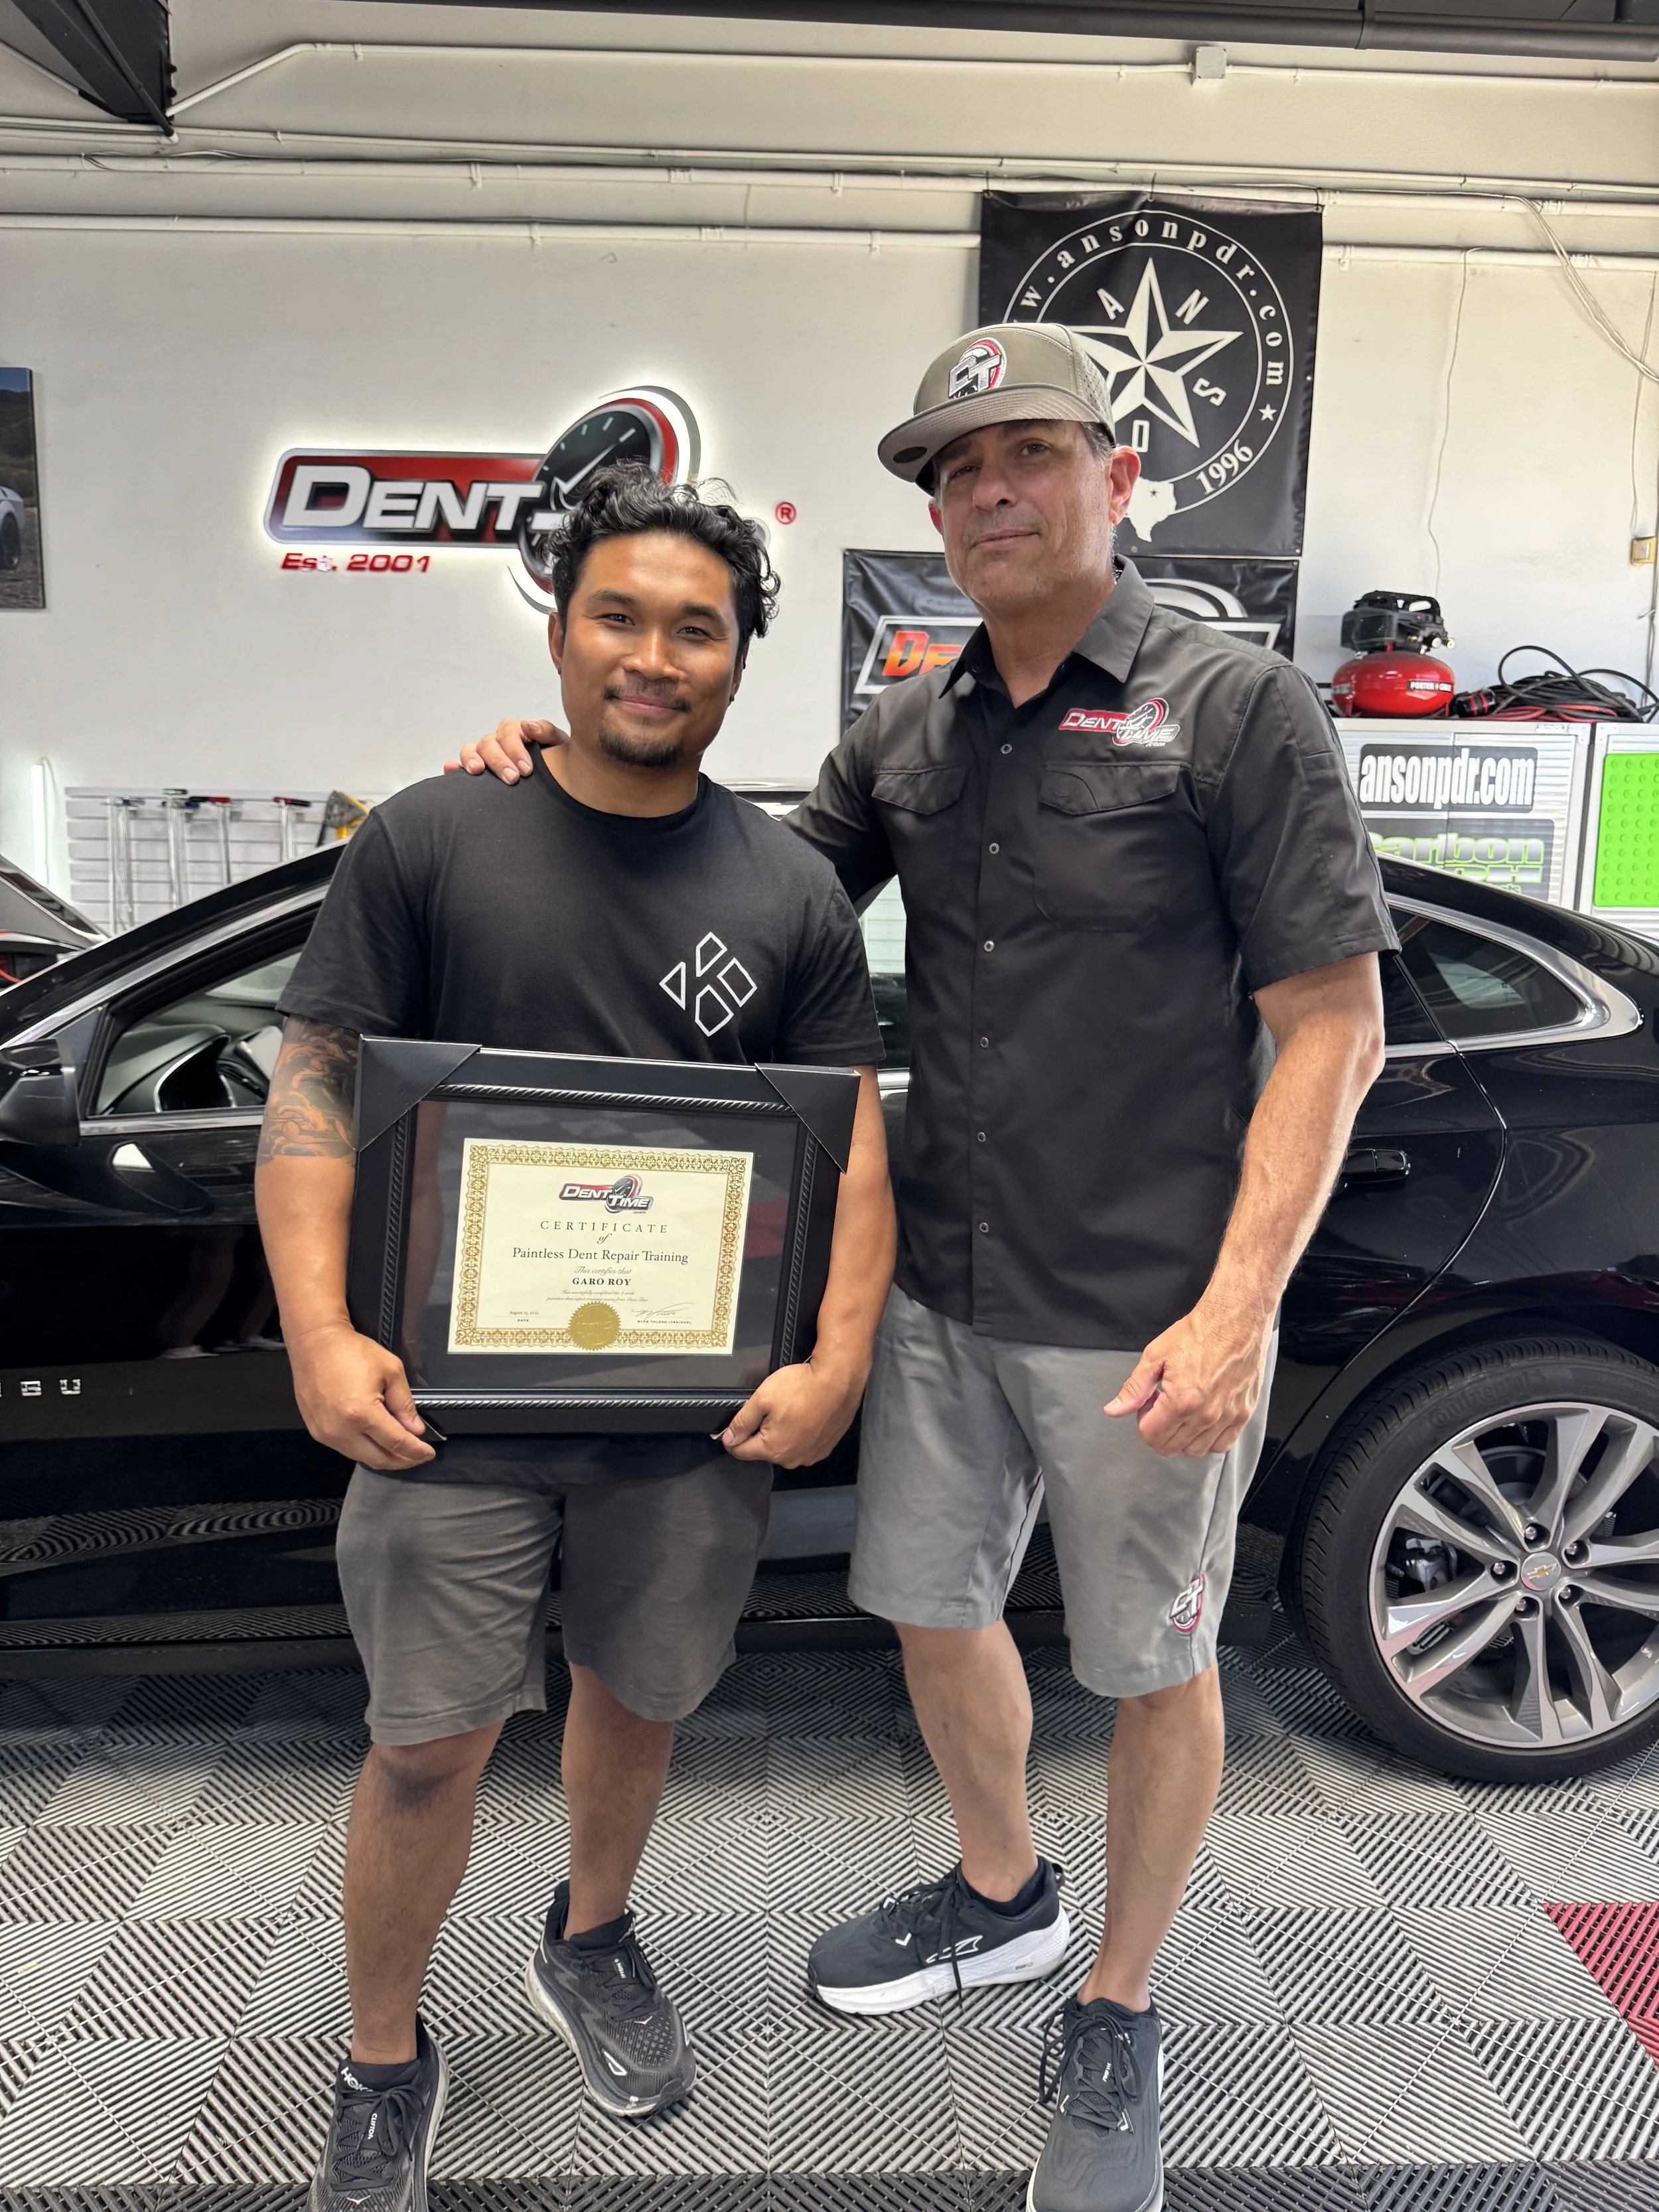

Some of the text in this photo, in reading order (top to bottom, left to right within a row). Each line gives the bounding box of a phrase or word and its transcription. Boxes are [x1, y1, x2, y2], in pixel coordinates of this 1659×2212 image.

[1014, 219, 1284, 386] w.ansonpdr.com
[1195, 439, 1254, 496] 1996
[283, 465, 544, 531] DENT
[346, 554, 431, 573] 2001
[1062, 712, 1126, 729] DENT
[1360, 748, 1535, 810] ansonpdr.com
[562, 1186, 613, 1199] DENT
[608, 1195, 650, 1208] TIME
[540, 1220, 668, 1233] CERTIFICATE
[597, 1233, 613, 1244] of
[512, 1247, 689, 1265] Paintless Dent Repair Training
[574, 1266, 591, 1274] This
[592, 1267, 616, 1276] certifies
[0, 1378, 81, 1397] BU
